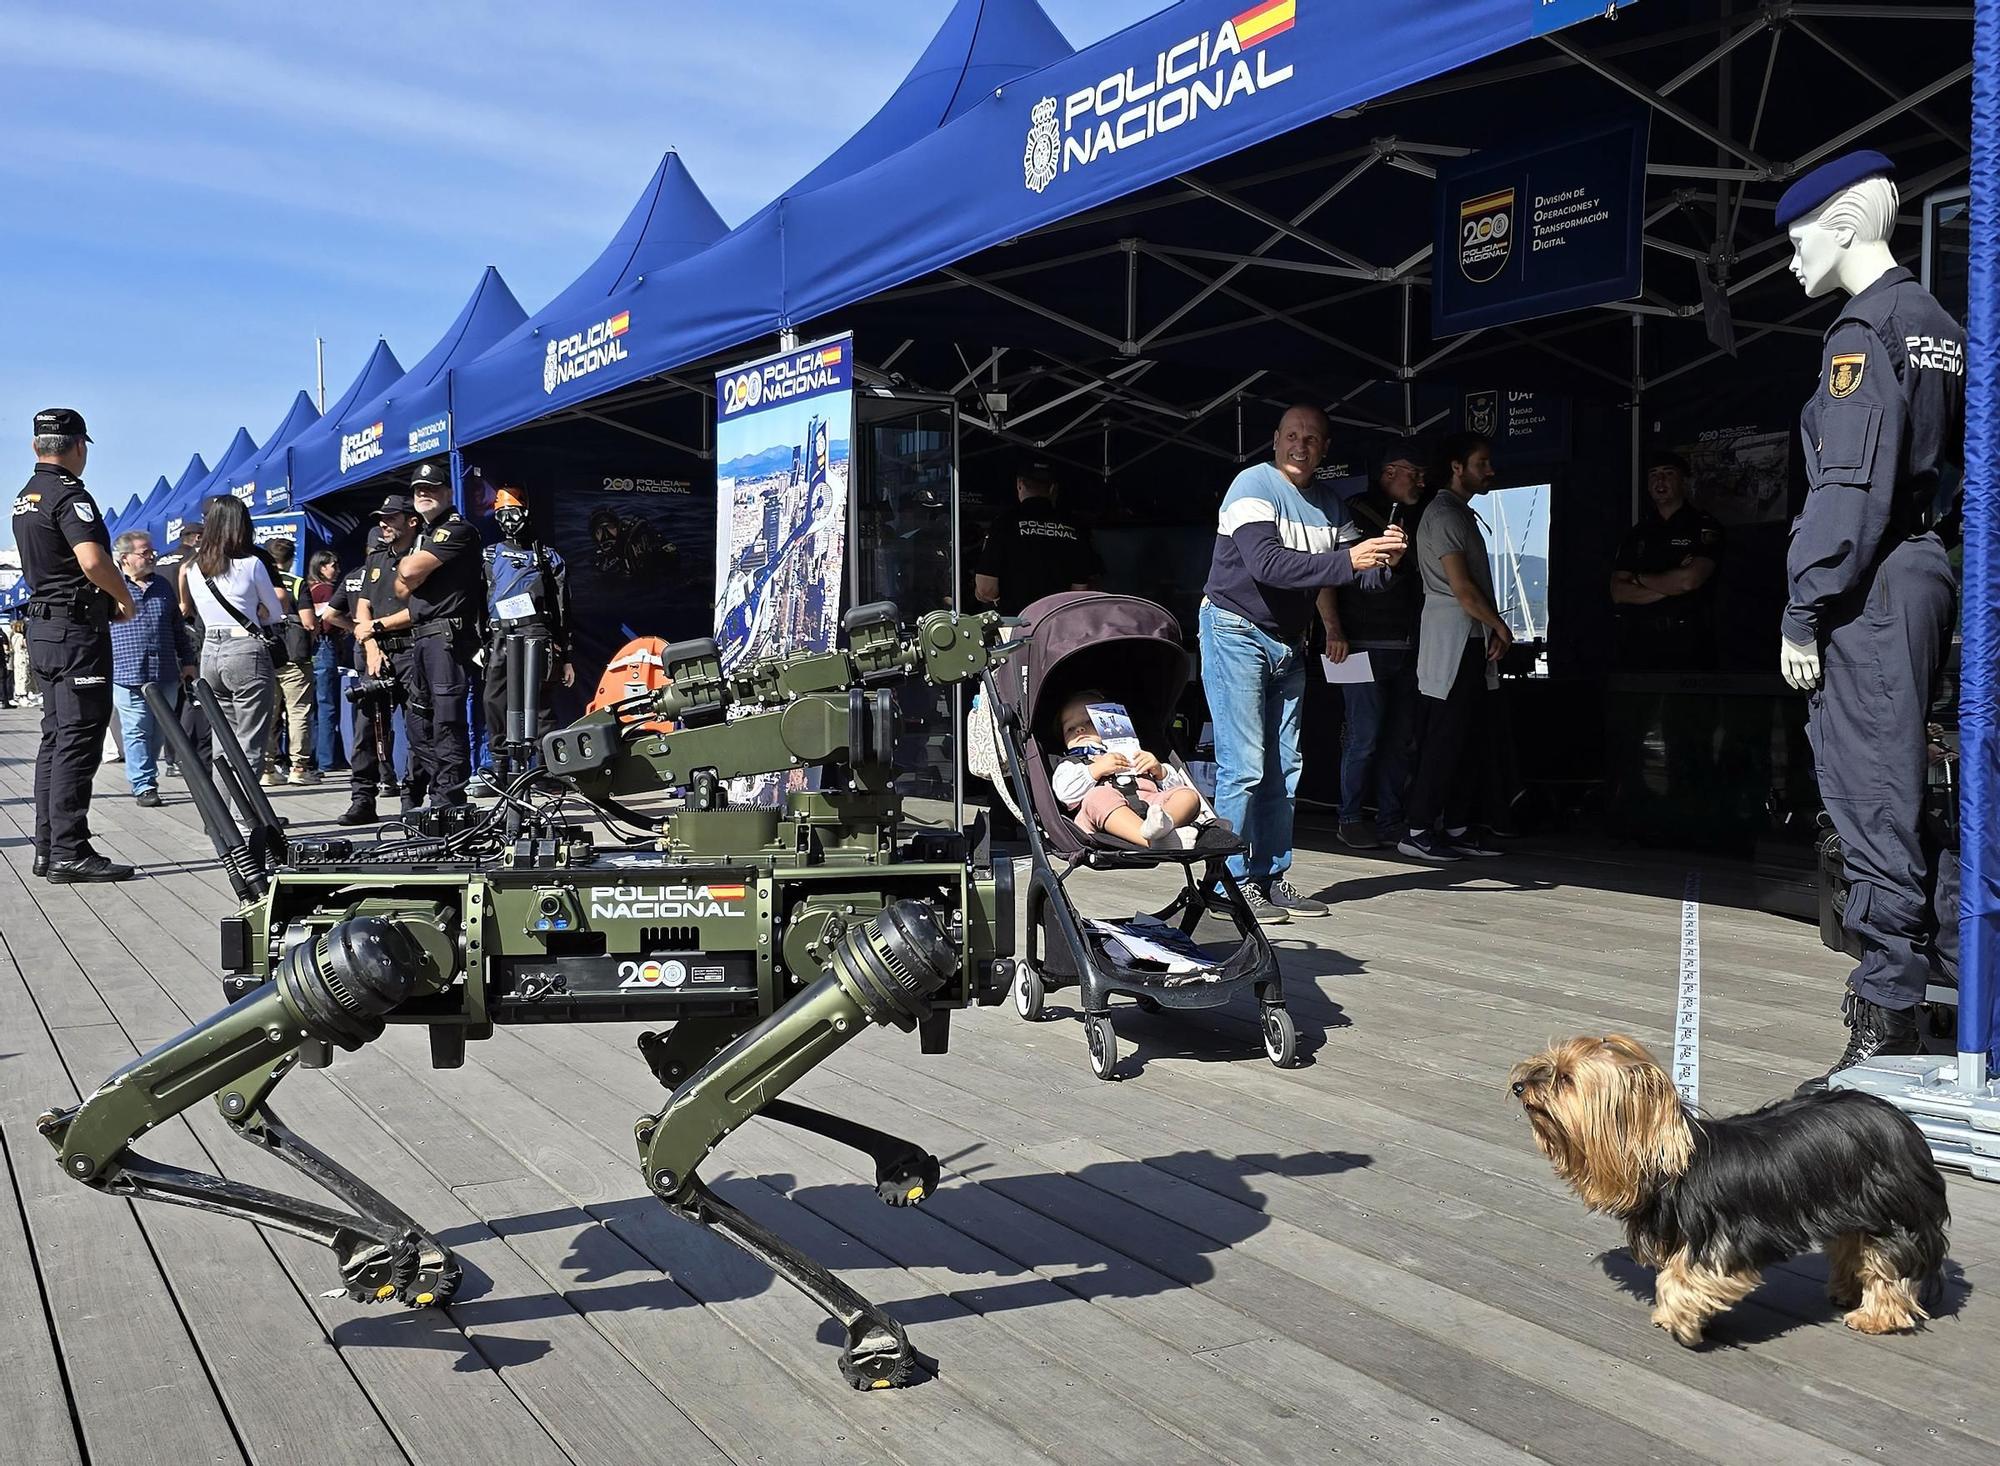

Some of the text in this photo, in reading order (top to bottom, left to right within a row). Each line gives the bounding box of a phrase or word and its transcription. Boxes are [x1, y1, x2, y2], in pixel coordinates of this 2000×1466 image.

[1062, 50, 1294, 173] NACIONAL
[1594, 198, 1600, 207] Y
[1463, 212, 1510, 248] 200
[1462, 249, 1508, 265] NACIONAL
[557, 318, 614, 362] POLICIA
[556, 339, 628, 386] NACIONAL
[763, 351, 825, 385] POLICIA
[724, 370, 763, 416] 200
[762, 368, 841, 404] NACIONAL
[603, 477, 634, 491] 200
[636, 486, 690, 494] NACIONAL
[1018, 520, 1065, 530] POLICIA
[1020, 528, 1078, 540] NACIONAL
[591, 901, 746, 919] NACIONAL
[617, 959, 687, 989] 200
